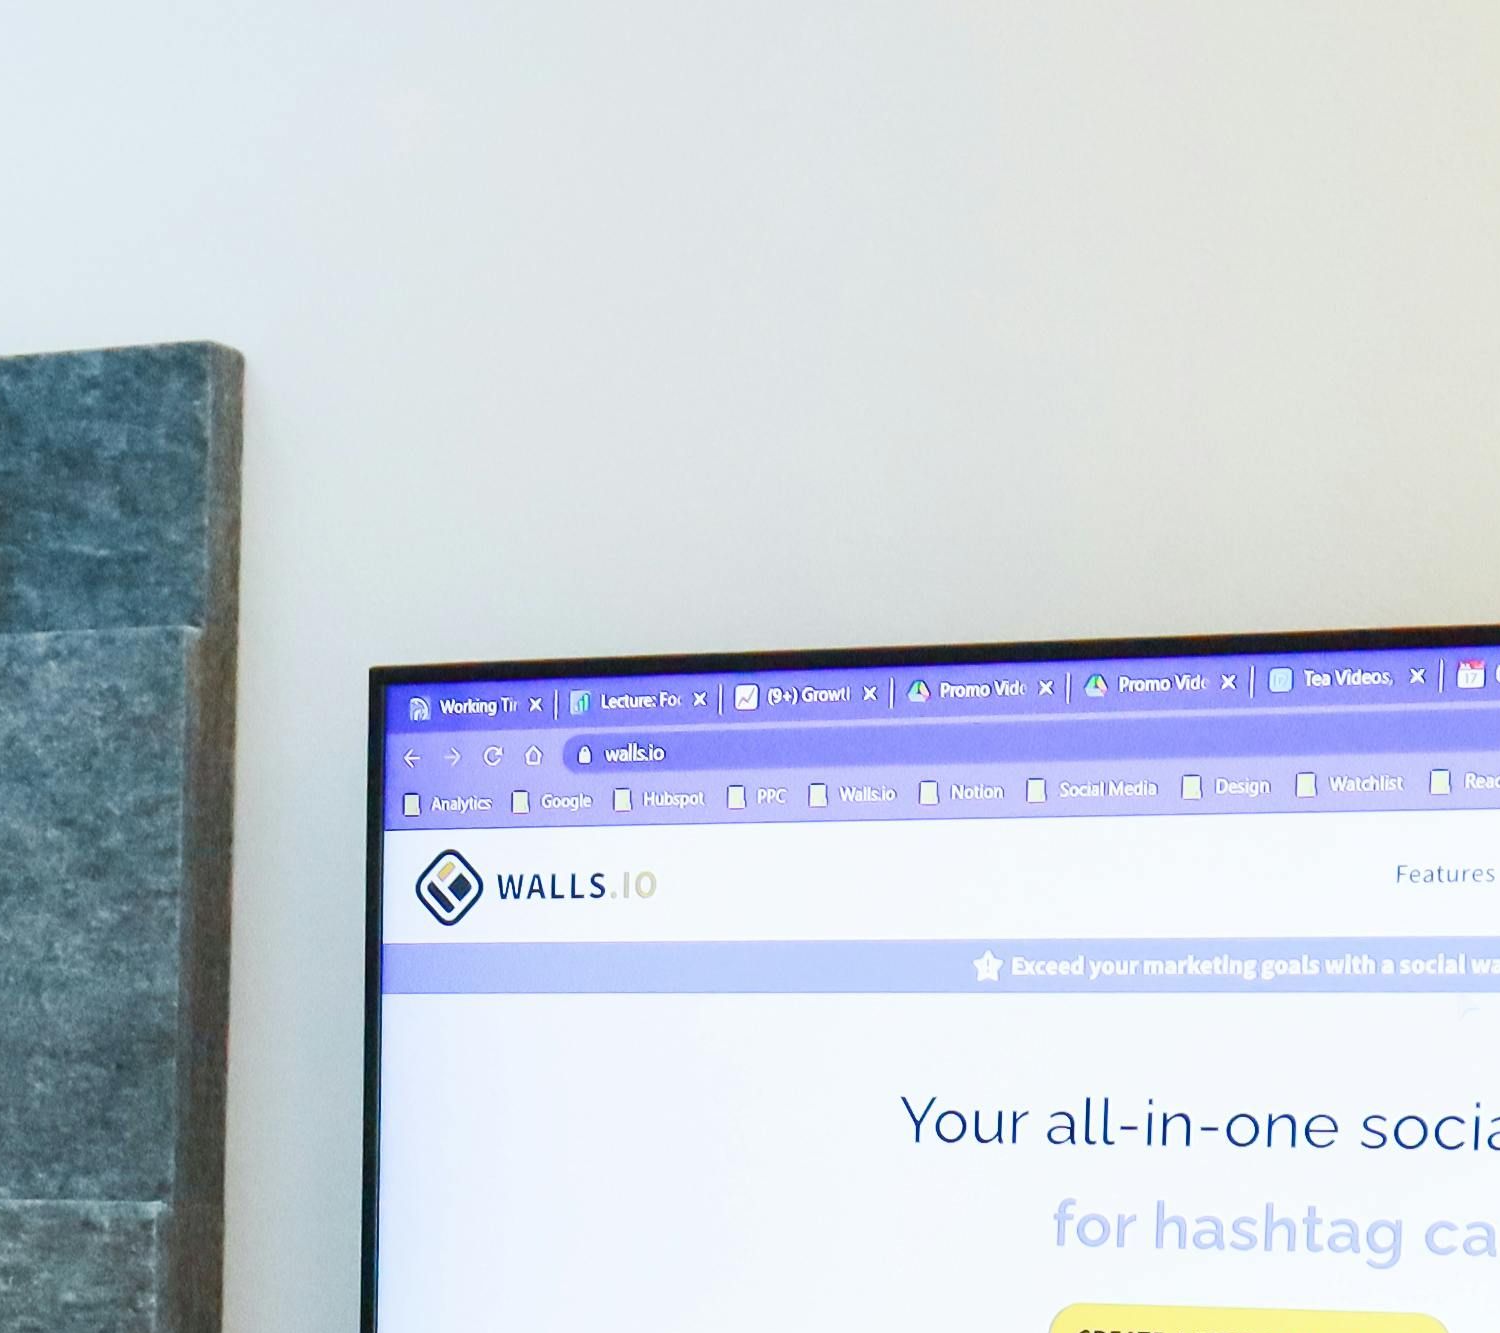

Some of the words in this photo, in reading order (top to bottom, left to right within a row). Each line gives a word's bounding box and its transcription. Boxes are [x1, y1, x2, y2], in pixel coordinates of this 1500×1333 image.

[1119, 675, 1170, 693] Promo
[1304, 669, 1331, 687] Tea
[768, 687, 798, 705] (9+)
[940, 680, 990, 698] Promo
[440, 699, 498, 716] Working
[601, 693, 656, 710] Lecture:
[605, 743, 667, 763] walls.io
[951, 783, 1004, 800] Notion
[1059, 780, 1105, 798] Social
[1108, 779, 1158, 797] Media
[1215, 777, 1271, 798] Design
[1329, 774, 1405, 793] Watchlist
[541, 793, 593, 812] Google
[643, 790, 705, 809] Hubspot
[757, 787, 788, 804] PPC
[838, 785, 898, 802] Walls.io
[431, 795, 493, 812] Analytics
[1396, 864, 1496, 883] Features
[497, 870, 657, 899] WALLS.IO
[1011, 956, 1085, 977] Exceed
[1088, 959, 1139, 981] your
[1143, 955, 1255, 981] marketing
[1260, 954, 1320, 980] goals
[1324, 953, 1377, 976] with
[1381, 958, 1396, 975] a
[1400, 953, 1466, 976] social
[900, 1095, 1030, 1145] Your
[1045, 1095, 1339, 1149] all-in-one
[1053, 1198, 1137, 1250] for
[1154, 1200, 1402, 1269] hashtag
